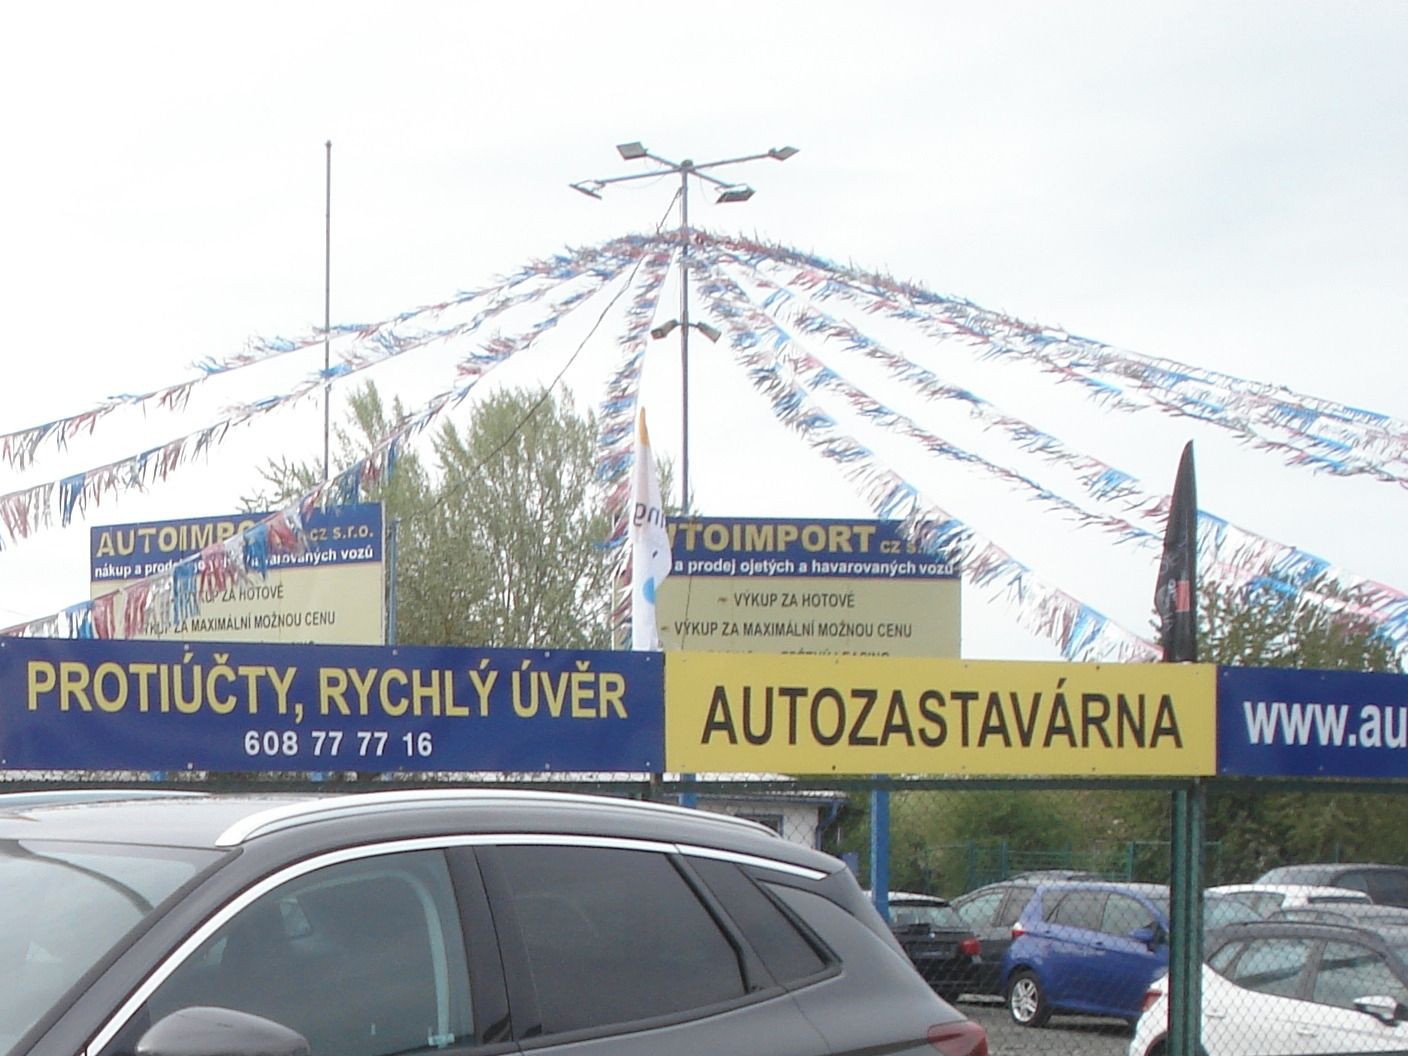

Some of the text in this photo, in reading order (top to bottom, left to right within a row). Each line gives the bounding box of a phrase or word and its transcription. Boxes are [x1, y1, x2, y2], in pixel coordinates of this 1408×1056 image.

[96, 519, 374, 558] AUTOIMP cz s.r.o.
[667, 523, 877, 553] TOIMPORT
[880, 540, 901, 554] cz
[95, 563, 132, 578] nákup
[135, 565, 142, 575] a
[675, 560, 684, 573] a
[688, 558, 736, 576] prodej
[740, 559, 795, 576] ojetých
[799, 561, 808, 573] a
[812, 559, 916, 577] havarovaných
[781, 592, 798, 608] ZA
[802, 590, 855, 608] HOTOVÉ
[192, 613, 251, 632] MAXIMÁLNÍ
[254, 612, 302, 629] MOŽNOU
[305, 611, 336, 626] CENU
[722, 622, 739, 636] ZA
[743, 619, 814, 637] MAXIMÁLNÍ
[818, 619, 874, 637] MOŽNOU
[877, 623, 912, 637] CENU
[27, 652, 628, 724] PROTIÚČTY, RYCHLÝ ÚVĚR
[700, 677, 1184, 749] AUTOZASTAVÁRNA
[1243, 701, 1408, 749] www.au
[244, 730, 433, 757] 608 77 77 16
